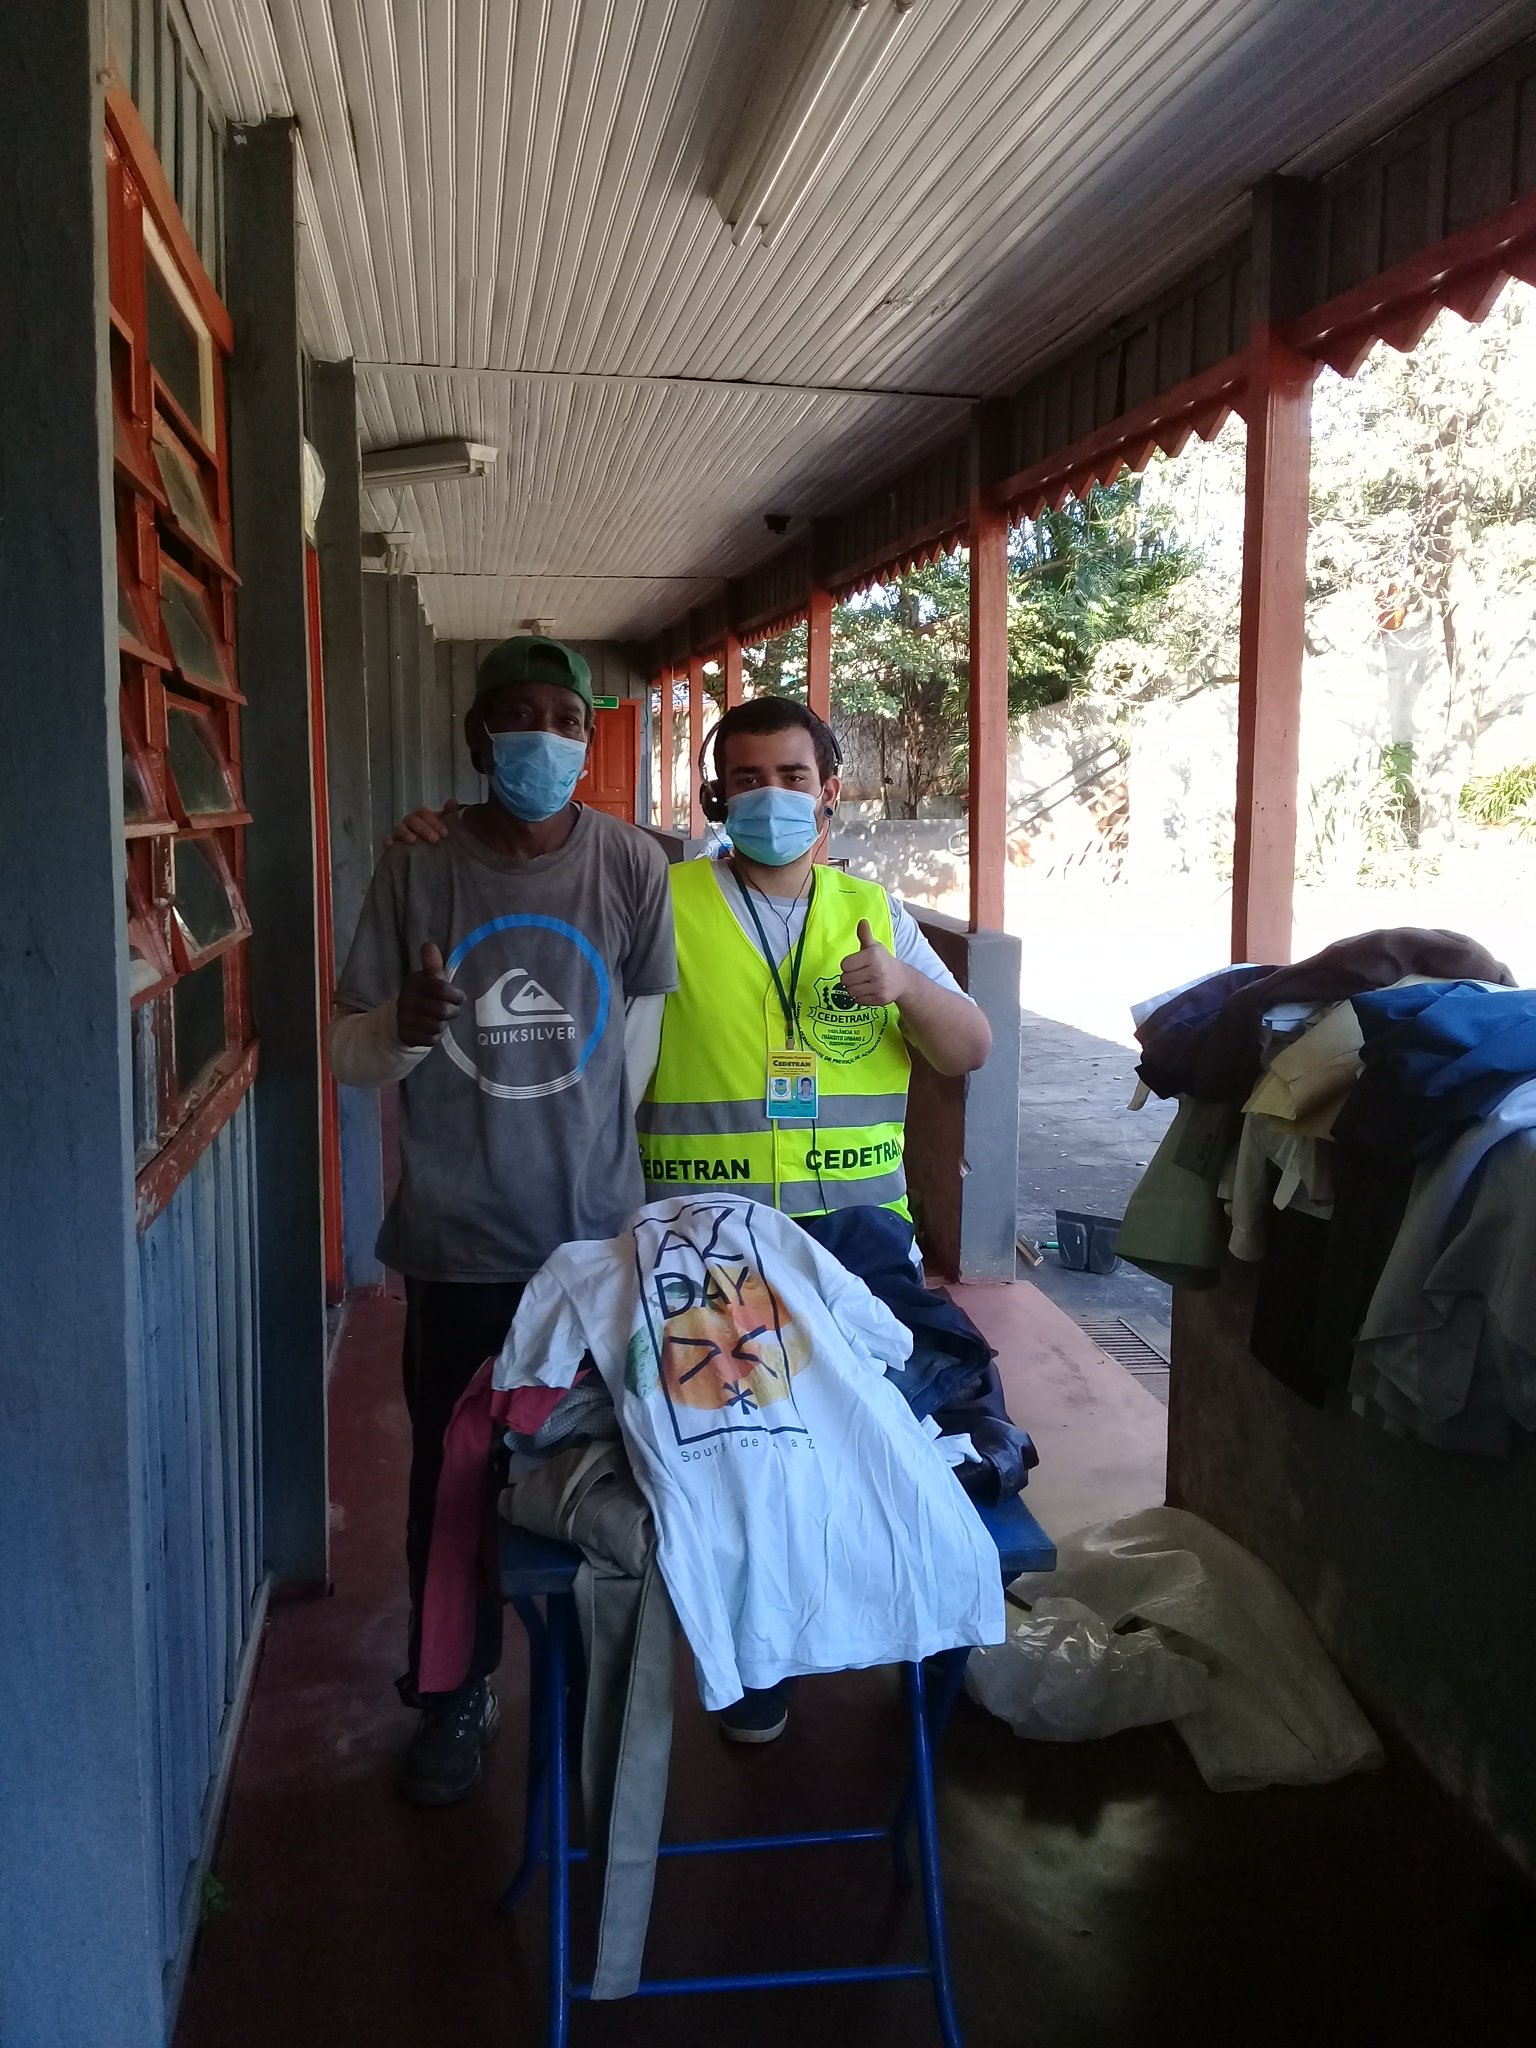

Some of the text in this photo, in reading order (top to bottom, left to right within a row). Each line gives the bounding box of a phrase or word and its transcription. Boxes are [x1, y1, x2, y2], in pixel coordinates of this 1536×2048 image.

[817, 1012, 870, 1024] CEDETRAN
[478, 1027, 576, 1045] QUIKSILVER
[640, 1158, 750, 1181] EDETRAN
[654, 1263, 750, 1321] DAY
[740, 1437, 759, 1448] de
[806, 1438, 816, 1450] Z
